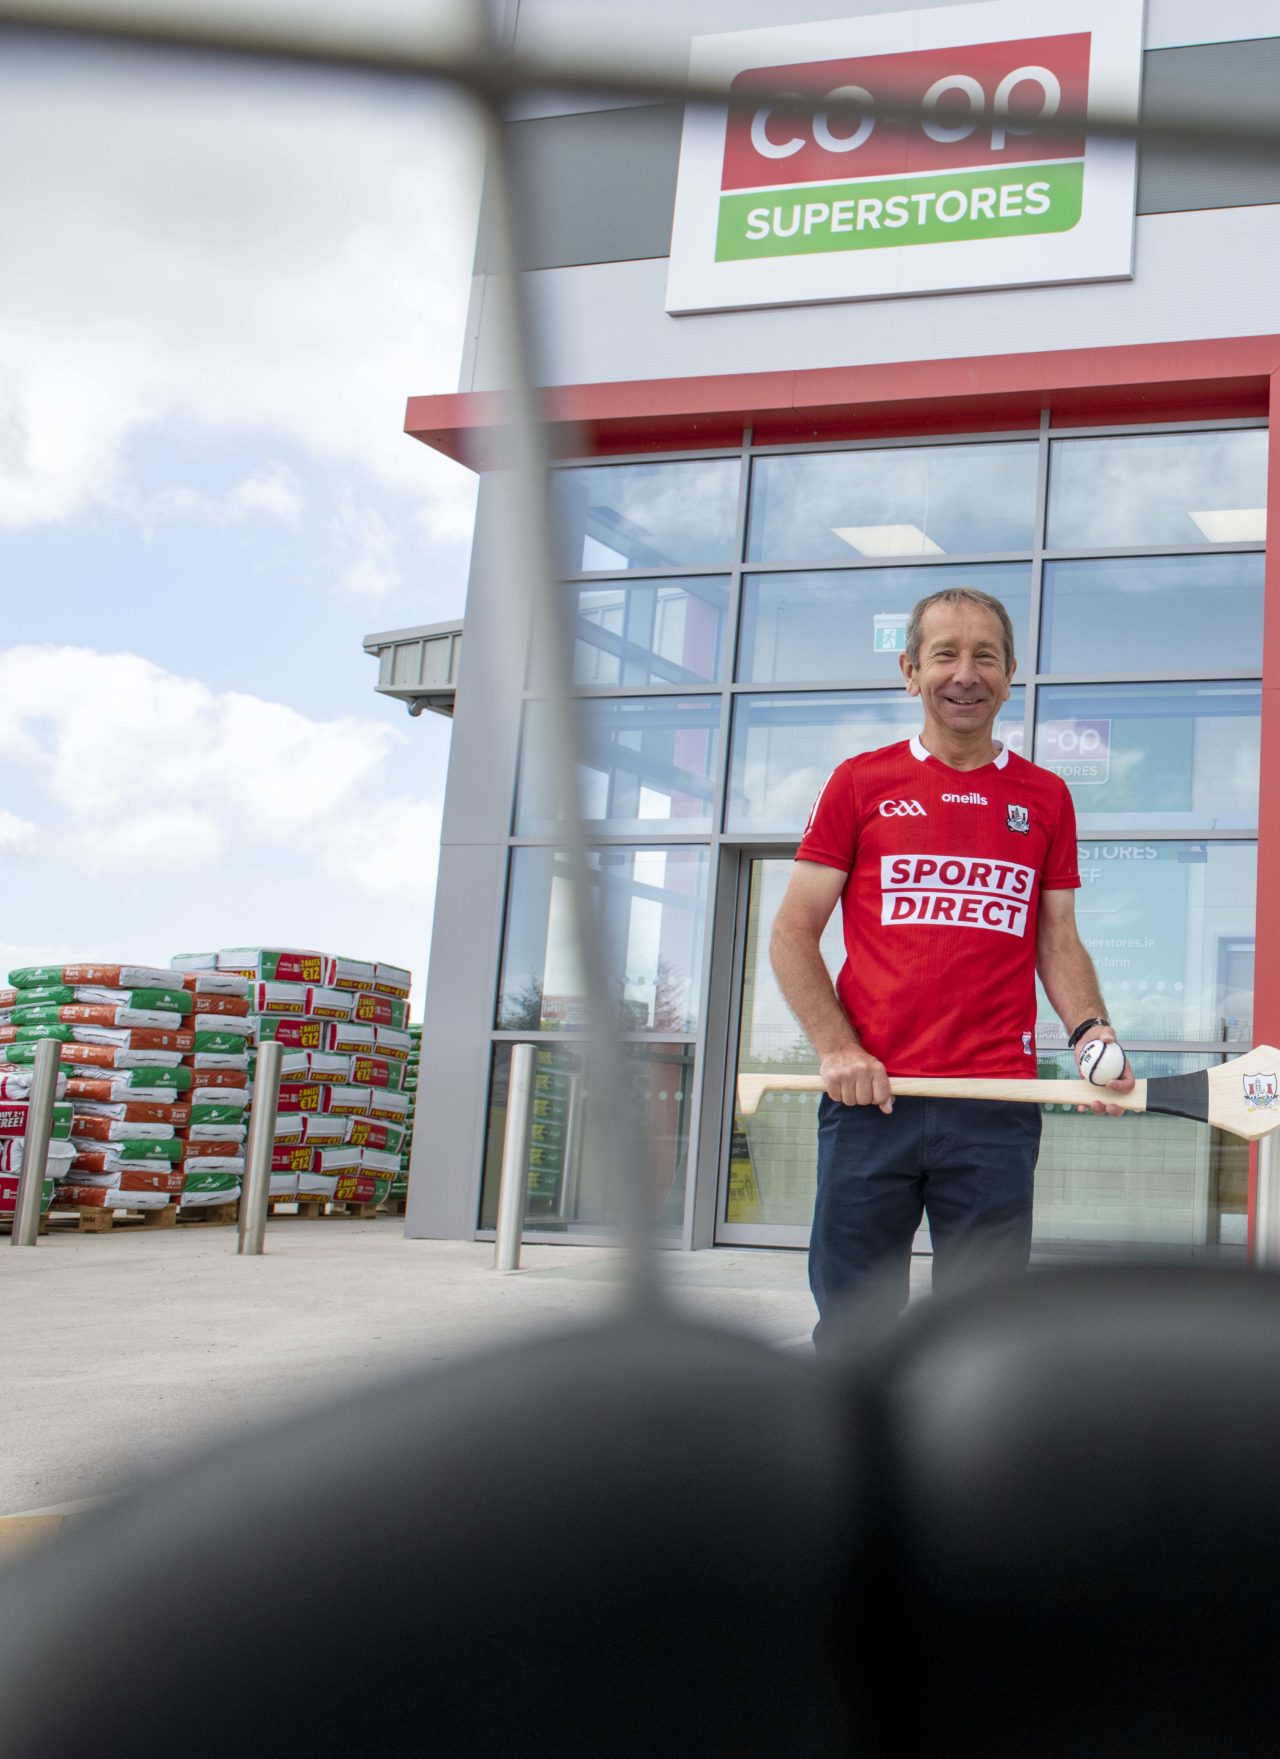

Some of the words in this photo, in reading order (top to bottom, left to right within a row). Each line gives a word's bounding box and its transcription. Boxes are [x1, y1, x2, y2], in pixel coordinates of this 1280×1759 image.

[750, 65, 1061, 159] coop
[744, 182, 1051, 240] SUPERSTORES
[1006, 728, 1100, 755] c-op
[879, 800, 927, 817] GAA
[890, 858, 1029, 894] SPORTS
[890, 896, 1022, 930] DIRECT
[303, 966, 320, 980] €12
[359, 1006, 374, 1018] €12
[301, 1032, 319, 1046] €12
[300, 1095, 318, 1109] €12
[291, 1156, 309, 1170] €12
